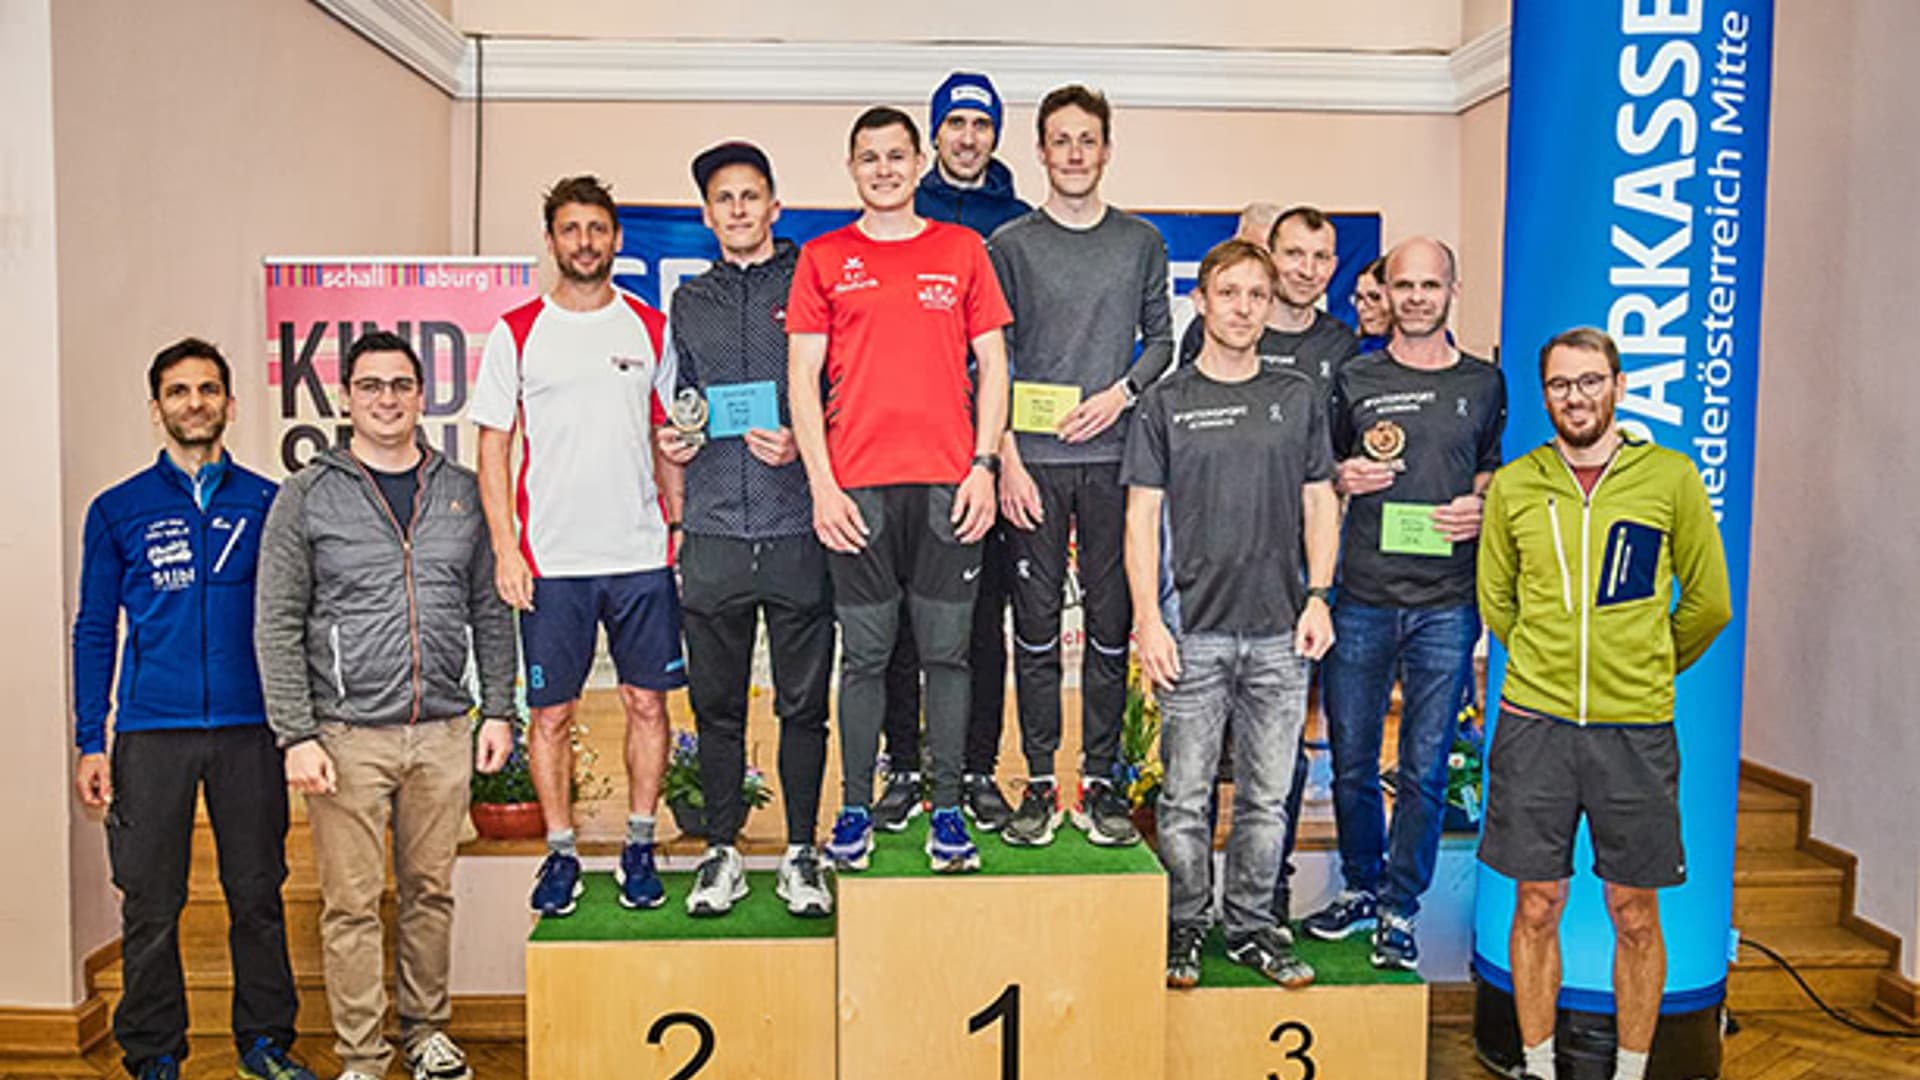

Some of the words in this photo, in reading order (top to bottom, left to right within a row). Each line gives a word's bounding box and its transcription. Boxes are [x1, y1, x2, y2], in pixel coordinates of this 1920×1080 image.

[1710, 11, 1750, 134] Mitte
[1607, 0, 1703, 446] ARKASSE
[322, 267, 384, 288] schall
[423, 267, 490, 291] aburg
[279, 321, 467, 419] KID
[1692, 150, 1743, 522] ederösterreich
[646, 1012, 715, 1080] 2
[967, 984, 1021, 1080] 1
[1266, 1021, 1315, 1080] 3
